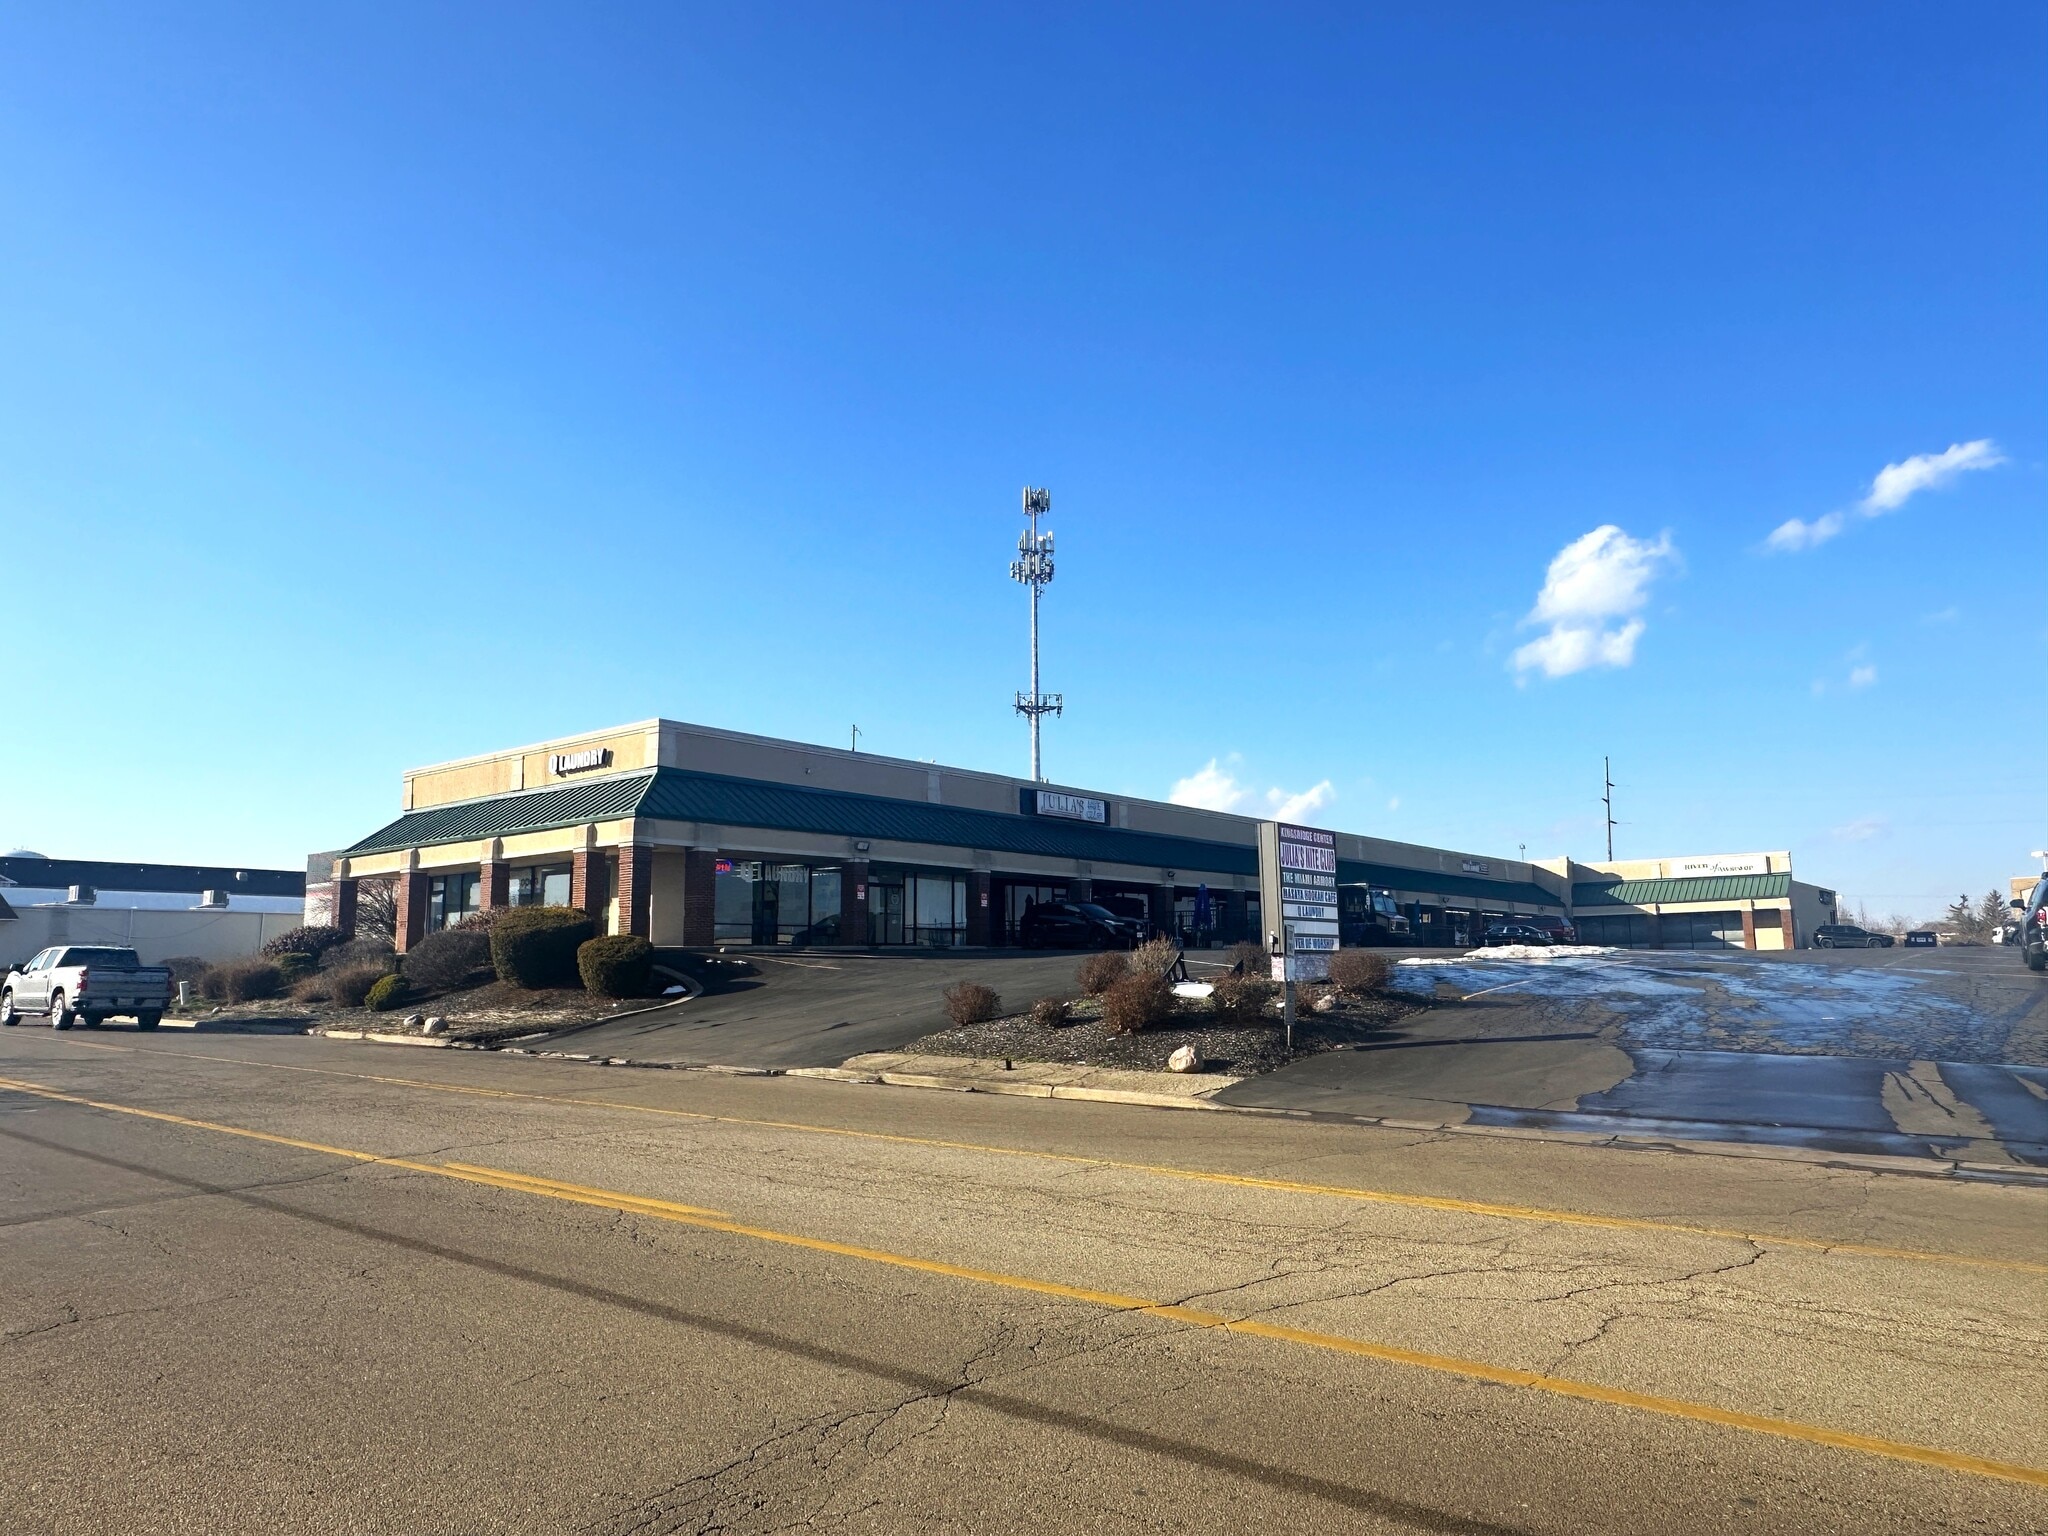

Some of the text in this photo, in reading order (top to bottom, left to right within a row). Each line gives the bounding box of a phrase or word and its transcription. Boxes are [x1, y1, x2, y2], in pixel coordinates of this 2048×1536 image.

[558, 748, 604, 772] LAUNDRY
[1041, 793, 1084, 813] JULIA'S
[1313, 832, 1333, 845] CENTER
[1281, 843, 1305, 868] JULIA'S
[1320, 848, 1335, 873] CLUB
[757, 863, 810, 883] LAUNDRY
[1283, 872, 1294, 884] THE
